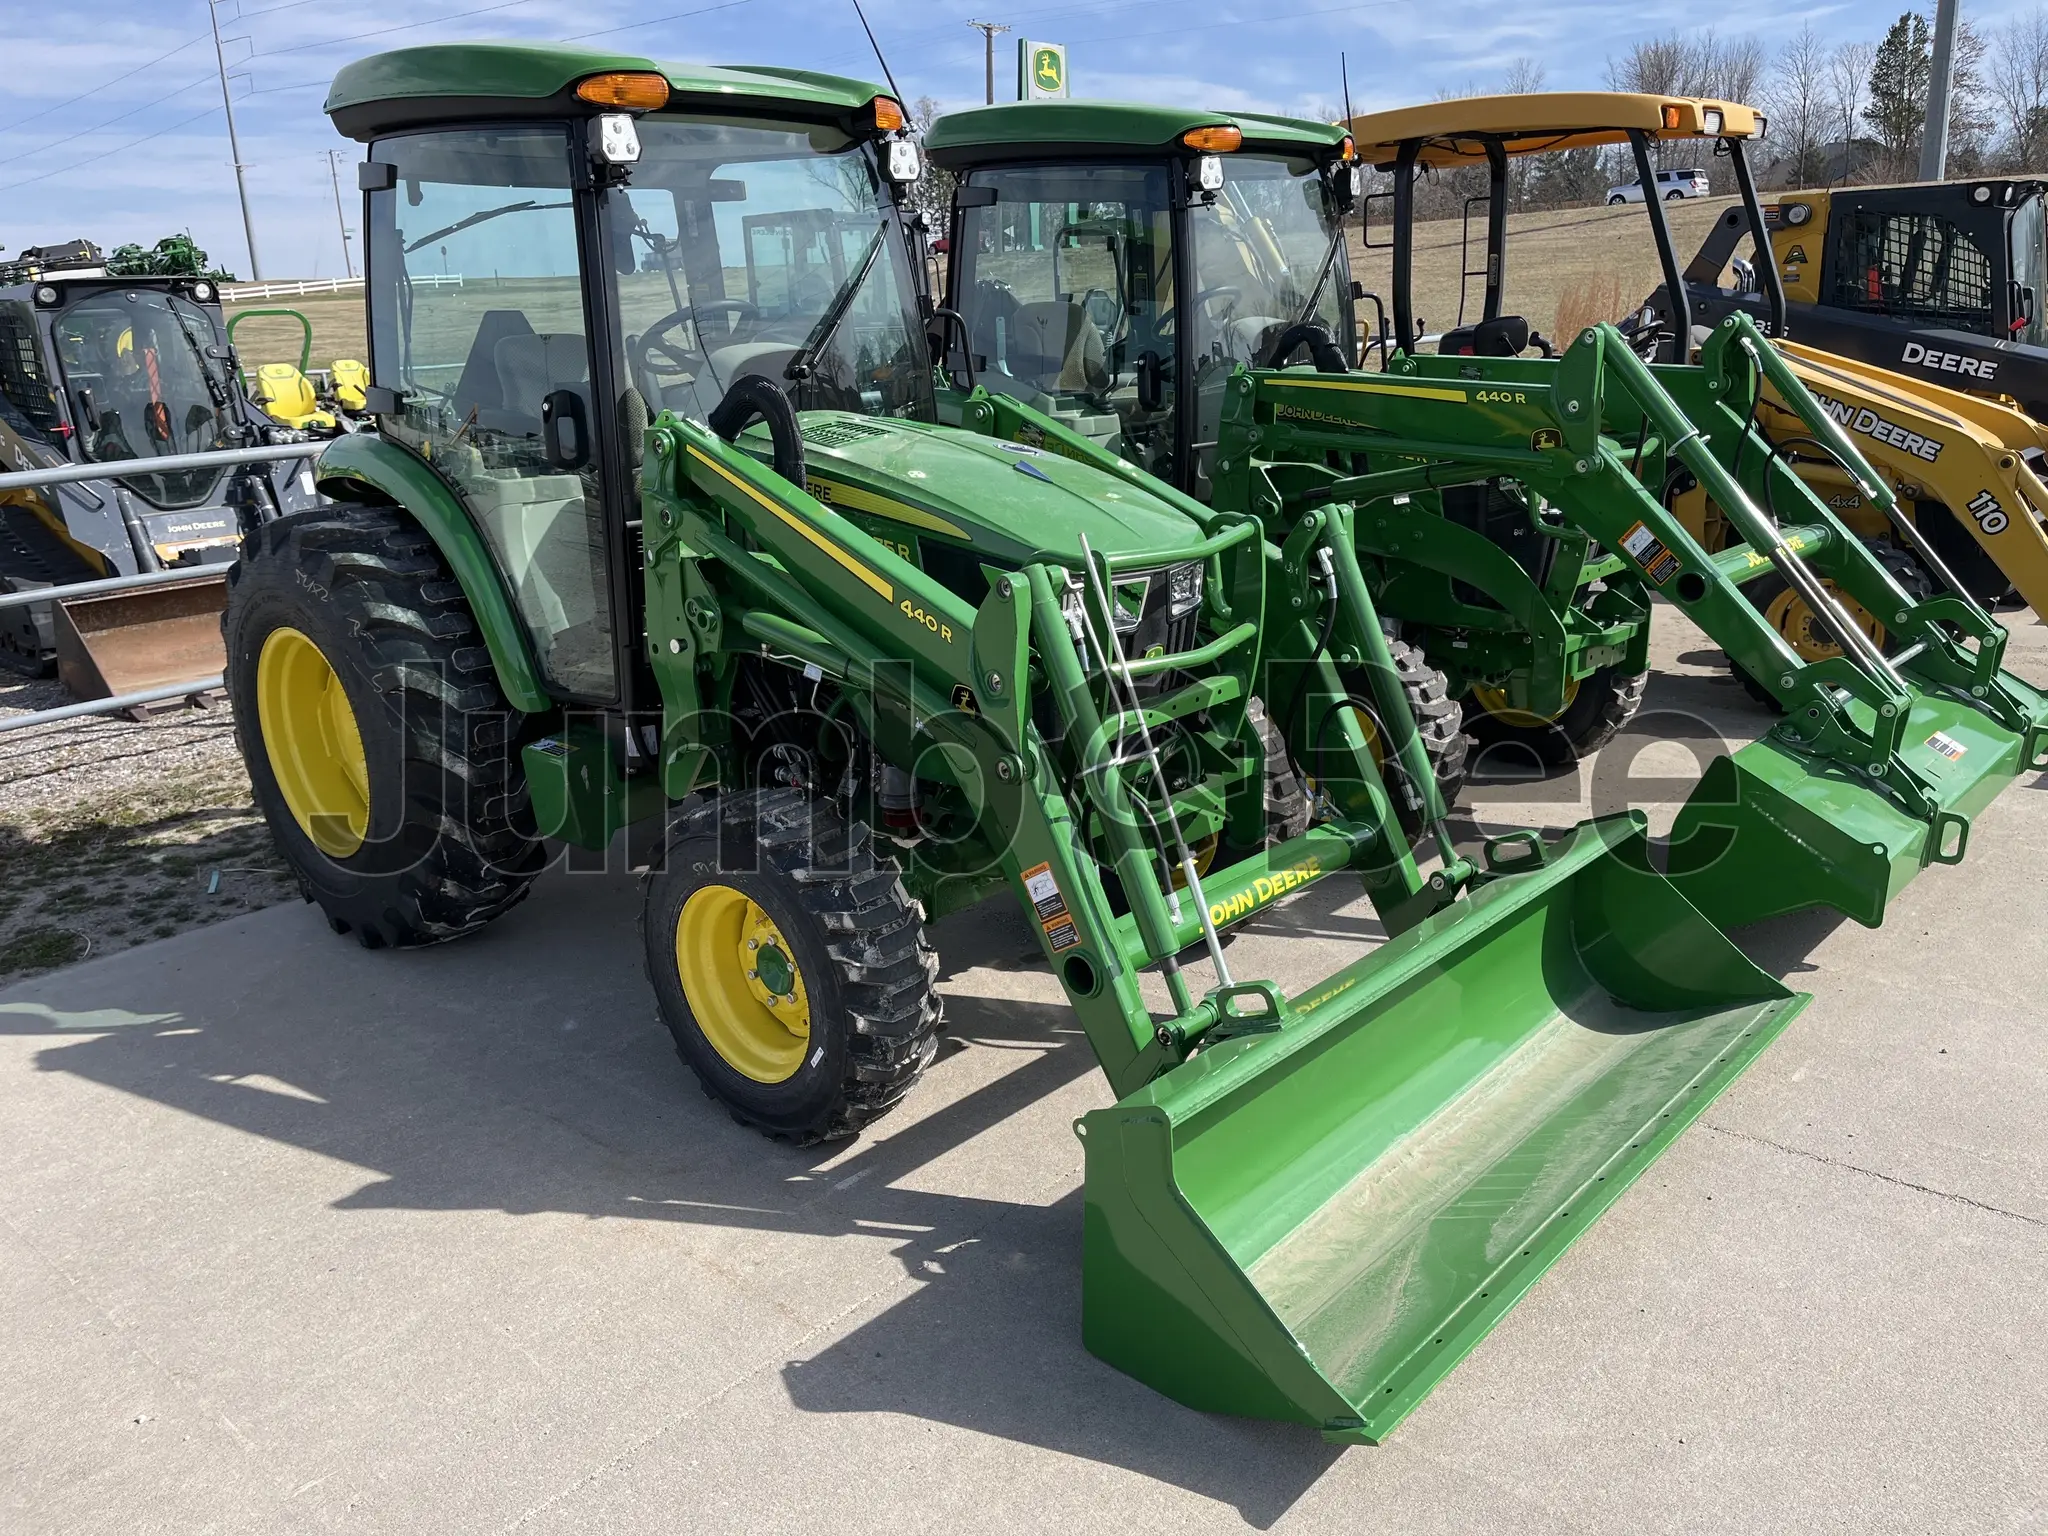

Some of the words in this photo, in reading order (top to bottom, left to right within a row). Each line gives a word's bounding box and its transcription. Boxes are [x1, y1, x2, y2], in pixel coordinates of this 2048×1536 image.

[1901, 342, 1998, 380] DEERE
[1278, 404, 1312, 420] JOHN
[1476, 390, 1512, 403] 440
[1514, 393, 1526, 404] R
[1803, 386, 1854, 425] HN
[1853, 406, 1945, 464] DEERE
[1829, 494, 1861, 509] 4x4
[1966, 489, 2009, 535] 110
[167, 525, 192, 533] JOHN
[192, 520, 226, 530] DEERE
[900, 599, 938, 632] 440
[941, 623, 953, 644] R
[1200, 888, 1255, 933] OHN
[1252, 855, 1322, 905] DEERE
